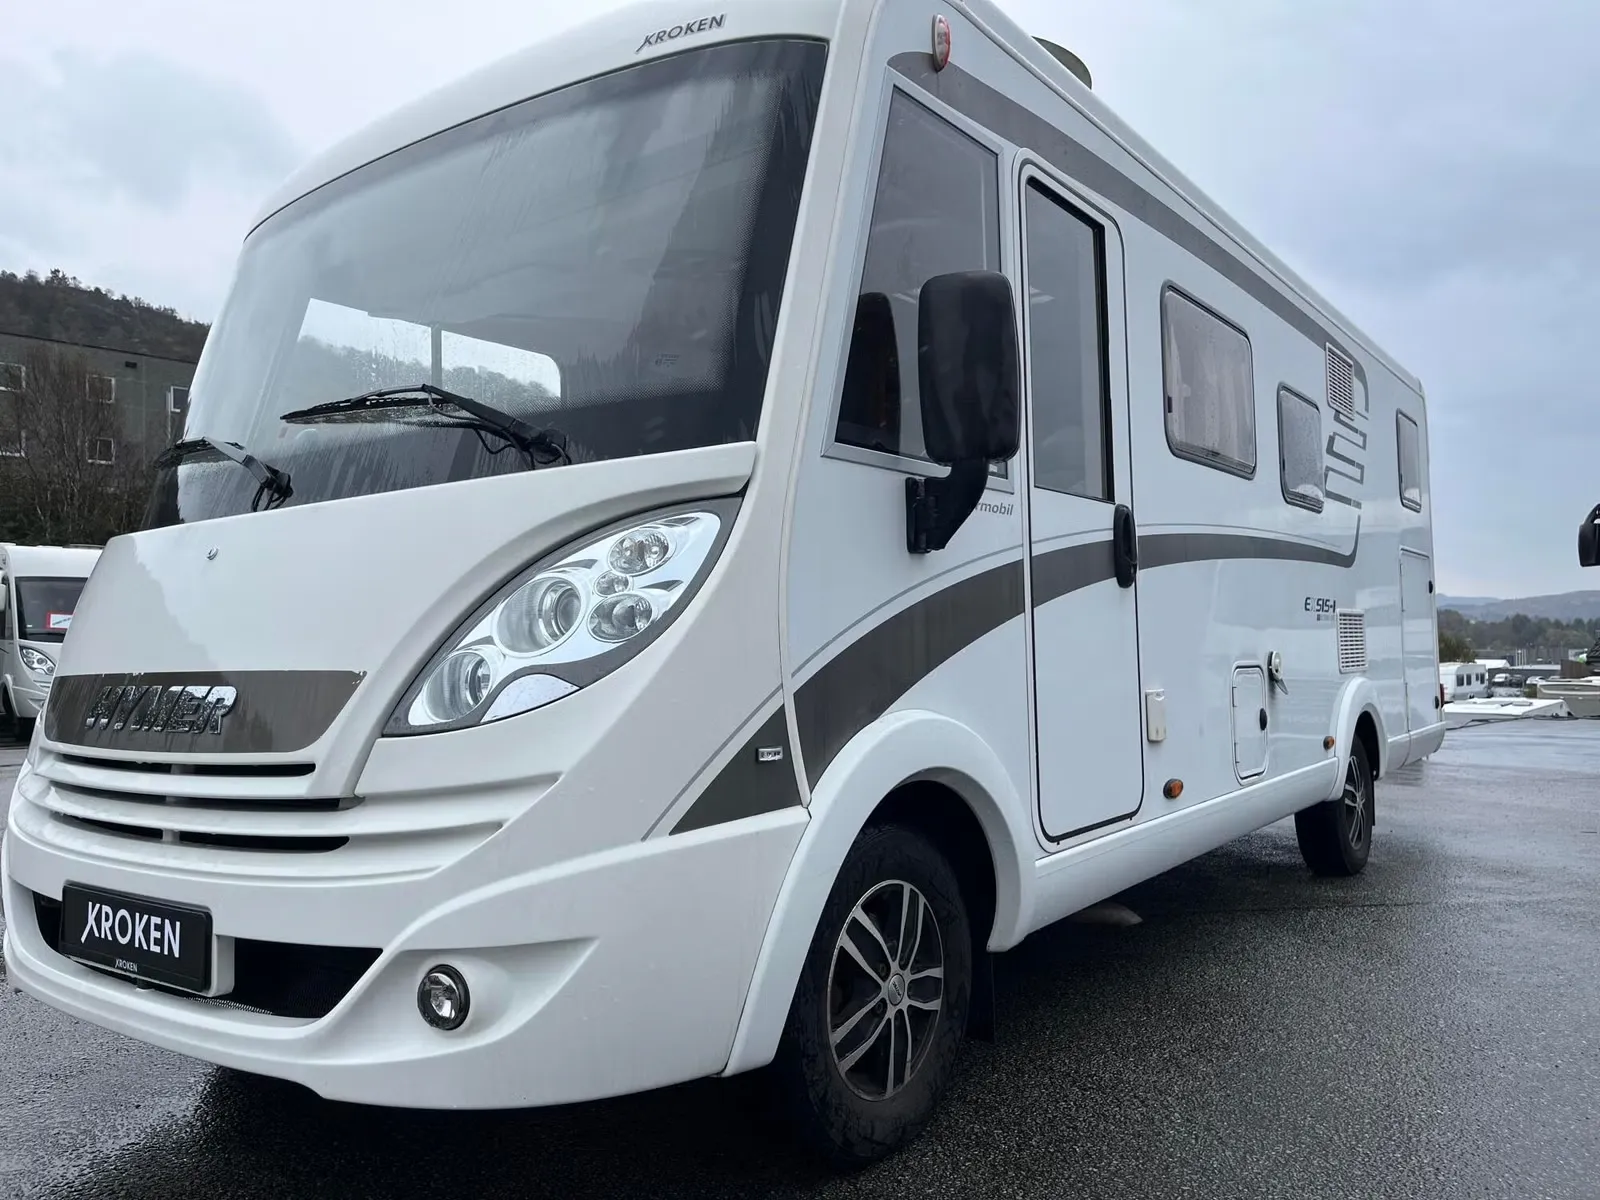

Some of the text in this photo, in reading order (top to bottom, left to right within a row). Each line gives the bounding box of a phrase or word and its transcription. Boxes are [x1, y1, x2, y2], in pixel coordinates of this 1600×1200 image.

[635, 13, 725, 53] KROKEN
[975, 502, 1014, 516] rmobil
[80, 901, 181, 959] KROKEN
[114, 958, 138, 972] KROKEN
